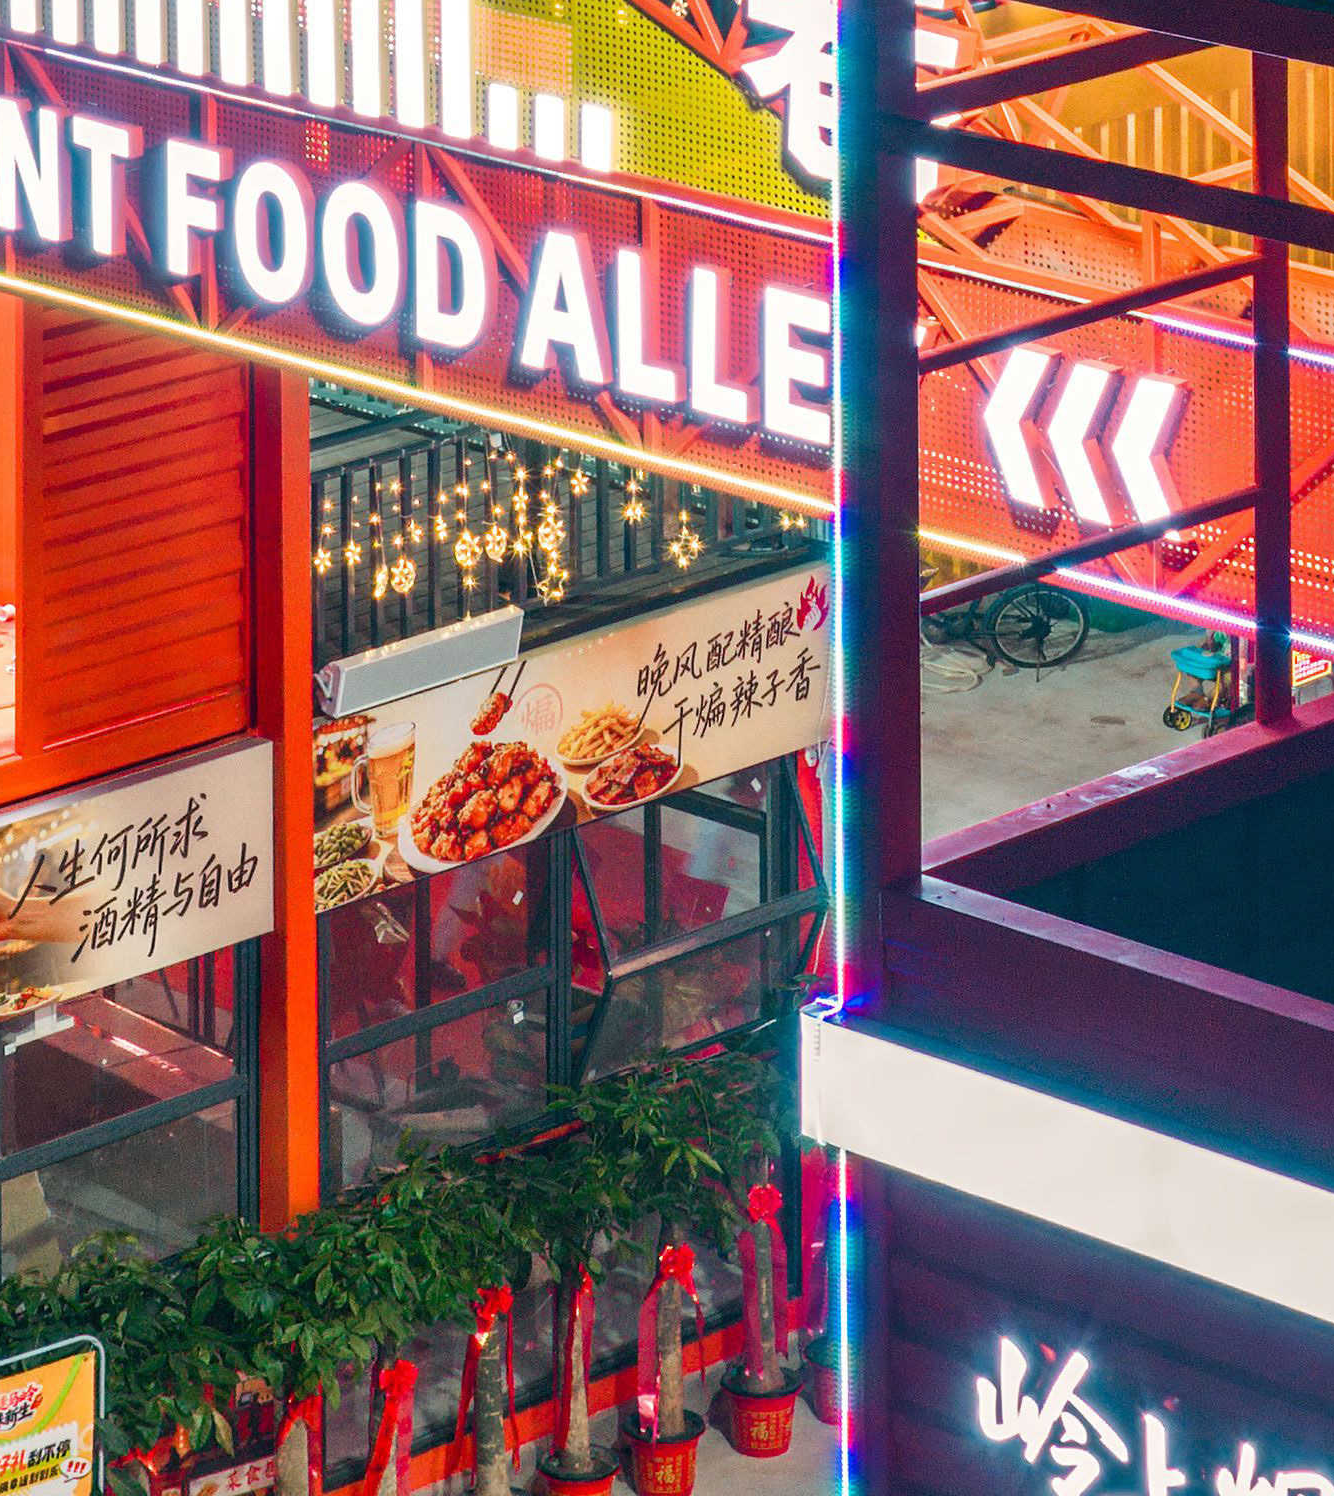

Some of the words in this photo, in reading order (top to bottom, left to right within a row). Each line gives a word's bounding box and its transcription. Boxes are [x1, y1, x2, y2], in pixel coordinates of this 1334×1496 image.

[164, 139, 485, 349] FOOD
[523, 230, 833, 446] ALLE
[636, 602, 802, 728] 晚风配精酿
[662, 649, 822, 765] 干煸辣子香
[8, 792, 209, 919] 人生何所求
[71, 842, 259, 963] 酒精与自由
